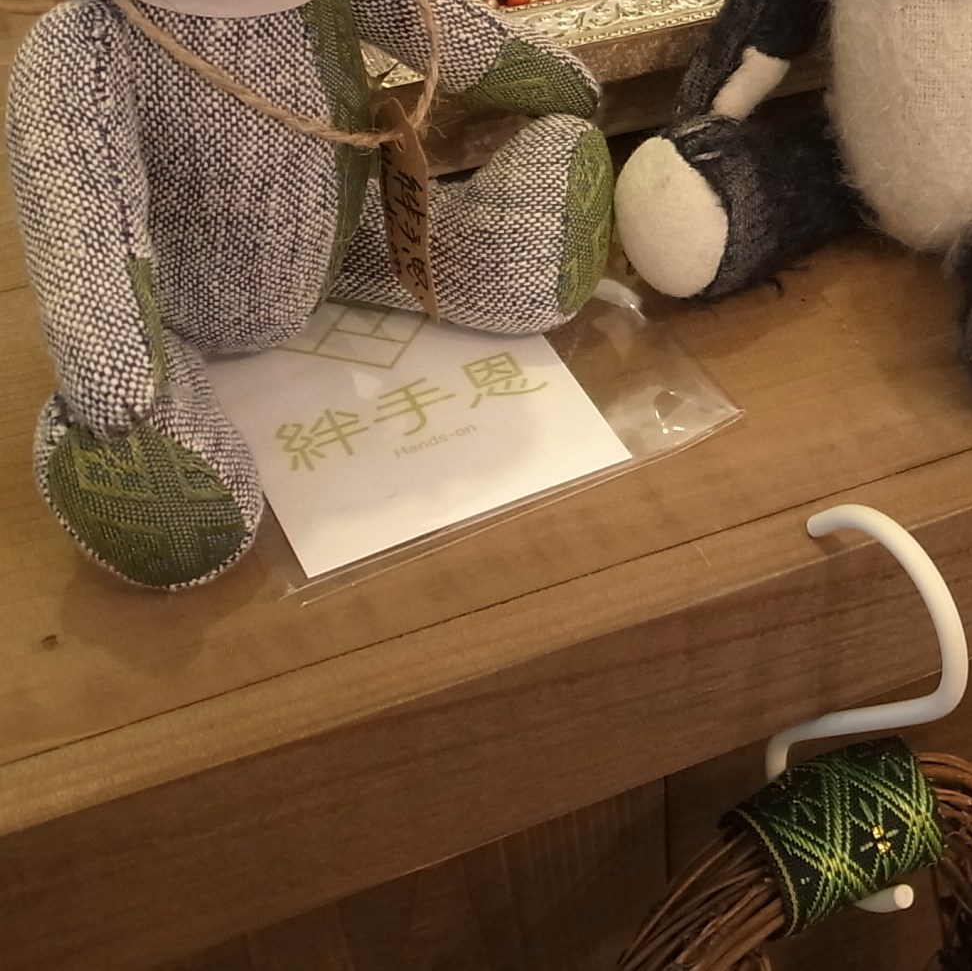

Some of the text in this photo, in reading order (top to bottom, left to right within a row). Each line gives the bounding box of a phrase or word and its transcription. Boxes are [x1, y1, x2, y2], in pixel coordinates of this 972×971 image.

[275, 351, 548, 471] 絆手恩
[392, 424, 477, 459] Hands-on
